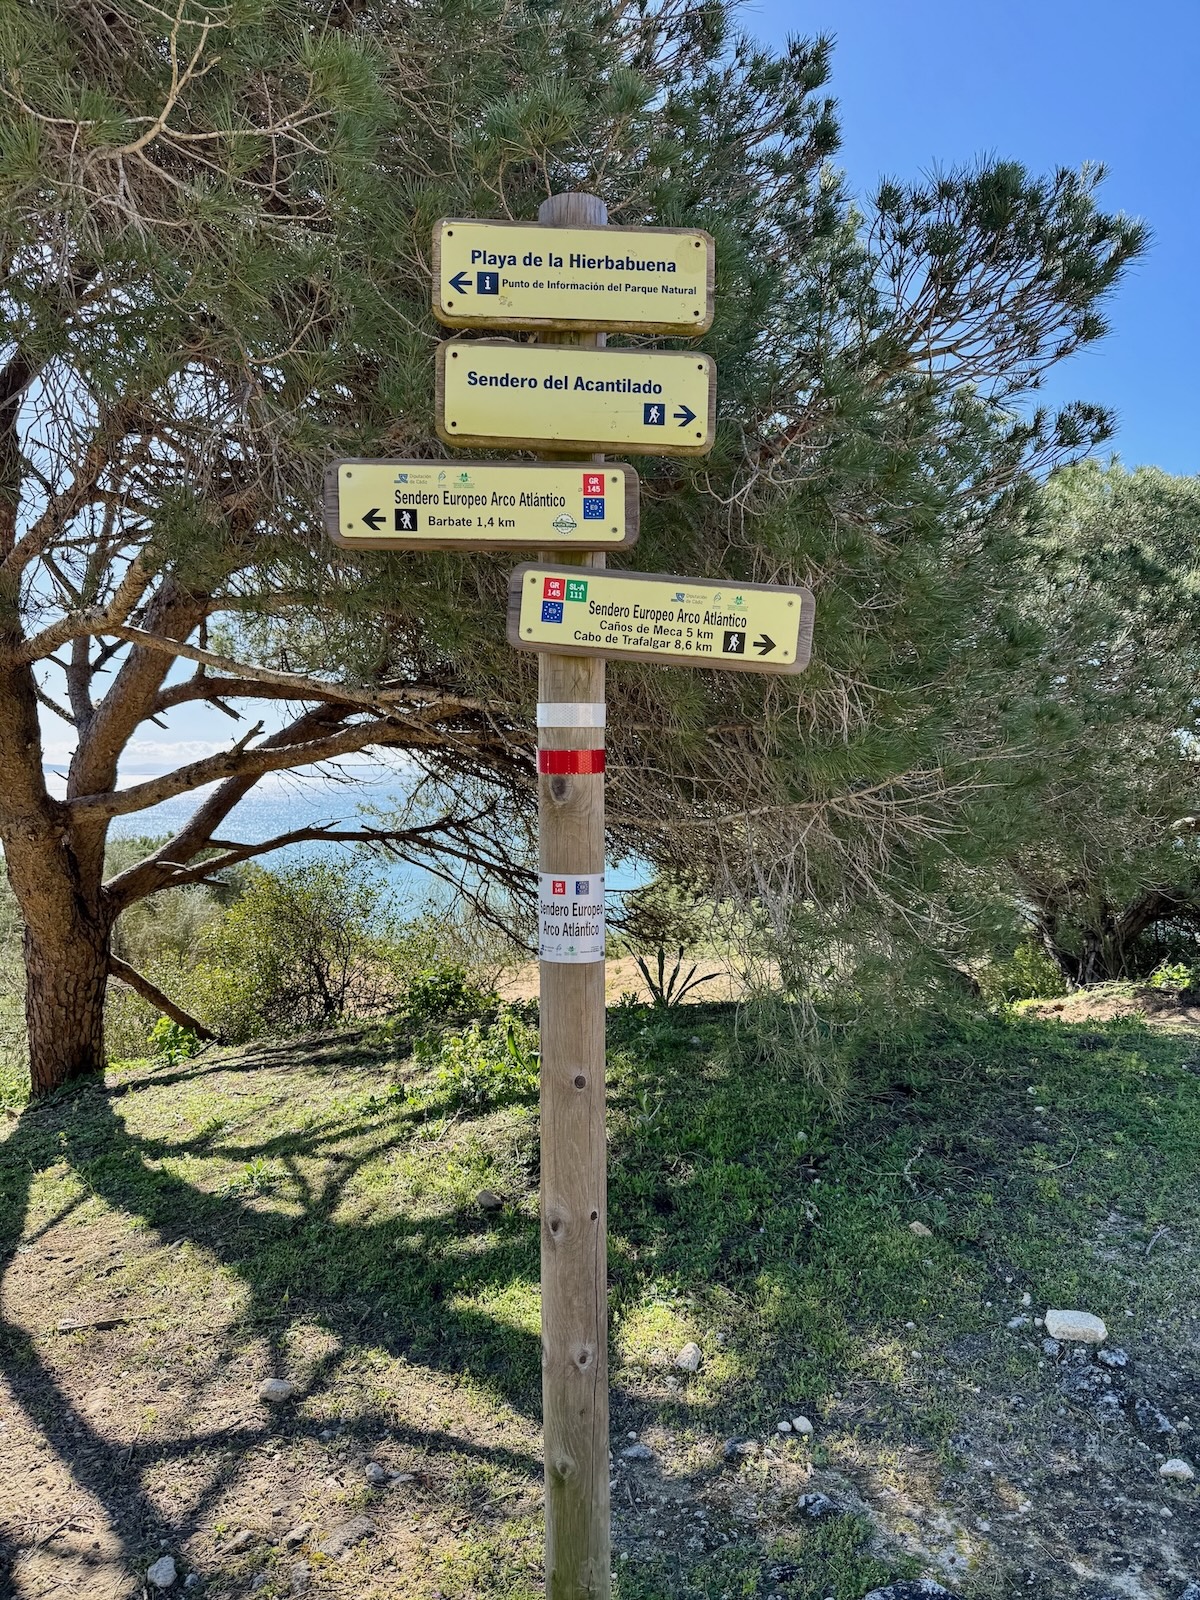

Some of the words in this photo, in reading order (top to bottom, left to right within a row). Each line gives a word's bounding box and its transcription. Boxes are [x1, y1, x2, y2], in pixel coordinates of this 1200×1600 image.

[471, 250, 517, 268] Playa
[522, 252, 543, 267] de
[548, 253, 563, 268] la
[569, 254, 676, 272] Hierbabuena
[502, 279, 530, 289] Punto
[532, 279, 545, 289] de
[547, 280, 605, 291] Información
[607, 282, 622, 292] del
[624, 283, 659, 295] Parque
[661, 285, 697, 295] Natural
[467, 371, 538, 389] Sendero
[543, 375, 568, 390] del
[573, 376, 662, 395] Acantilado
[588, 477, 599, 485] GR
[587, 485, 601, 493] 145
[395, 489, 439, 504] Sendero
[443, 490, 487, 509] Europeo
[491, 491, 516, 506] Arco
[519, 492, 566, 507] Atlántico
[428, 515, 472, 527] Barbate
[476, 516, 495, 529] 1,4
[498, 517, 516, 528] km
[549, 581, 560, 589] GR
[569, 583, 585, 591] SL-A
[547, 589, 561, 597] 145
[569, 591, 583, 599] 111
[589, 600, 630, 618] Sendero
[633, 604, 674, 623] Europeo
[677, 608, 700, 624] Arco
[703, 611, 747, 628] Atlántico
[600, 620, 633, 632] Caños
[636, 624, 649, 634] de
[653, 625, 682, 637] Meca
[686, 628, 693, 638] 5
[697, 629, 714, 639] km
[574, 630, 601, 642] Cabo
[605, 633, 619, 644] de
[622, 635, 671, 649] Trafalgar
[674, 639, 692, 651] 8,6
[695, 641, 712, 652] km
[572, 902, 603, 919] Europeo
[543, 921, 560, 935] Arco
[562, 922, 599, 936] Atlántico
